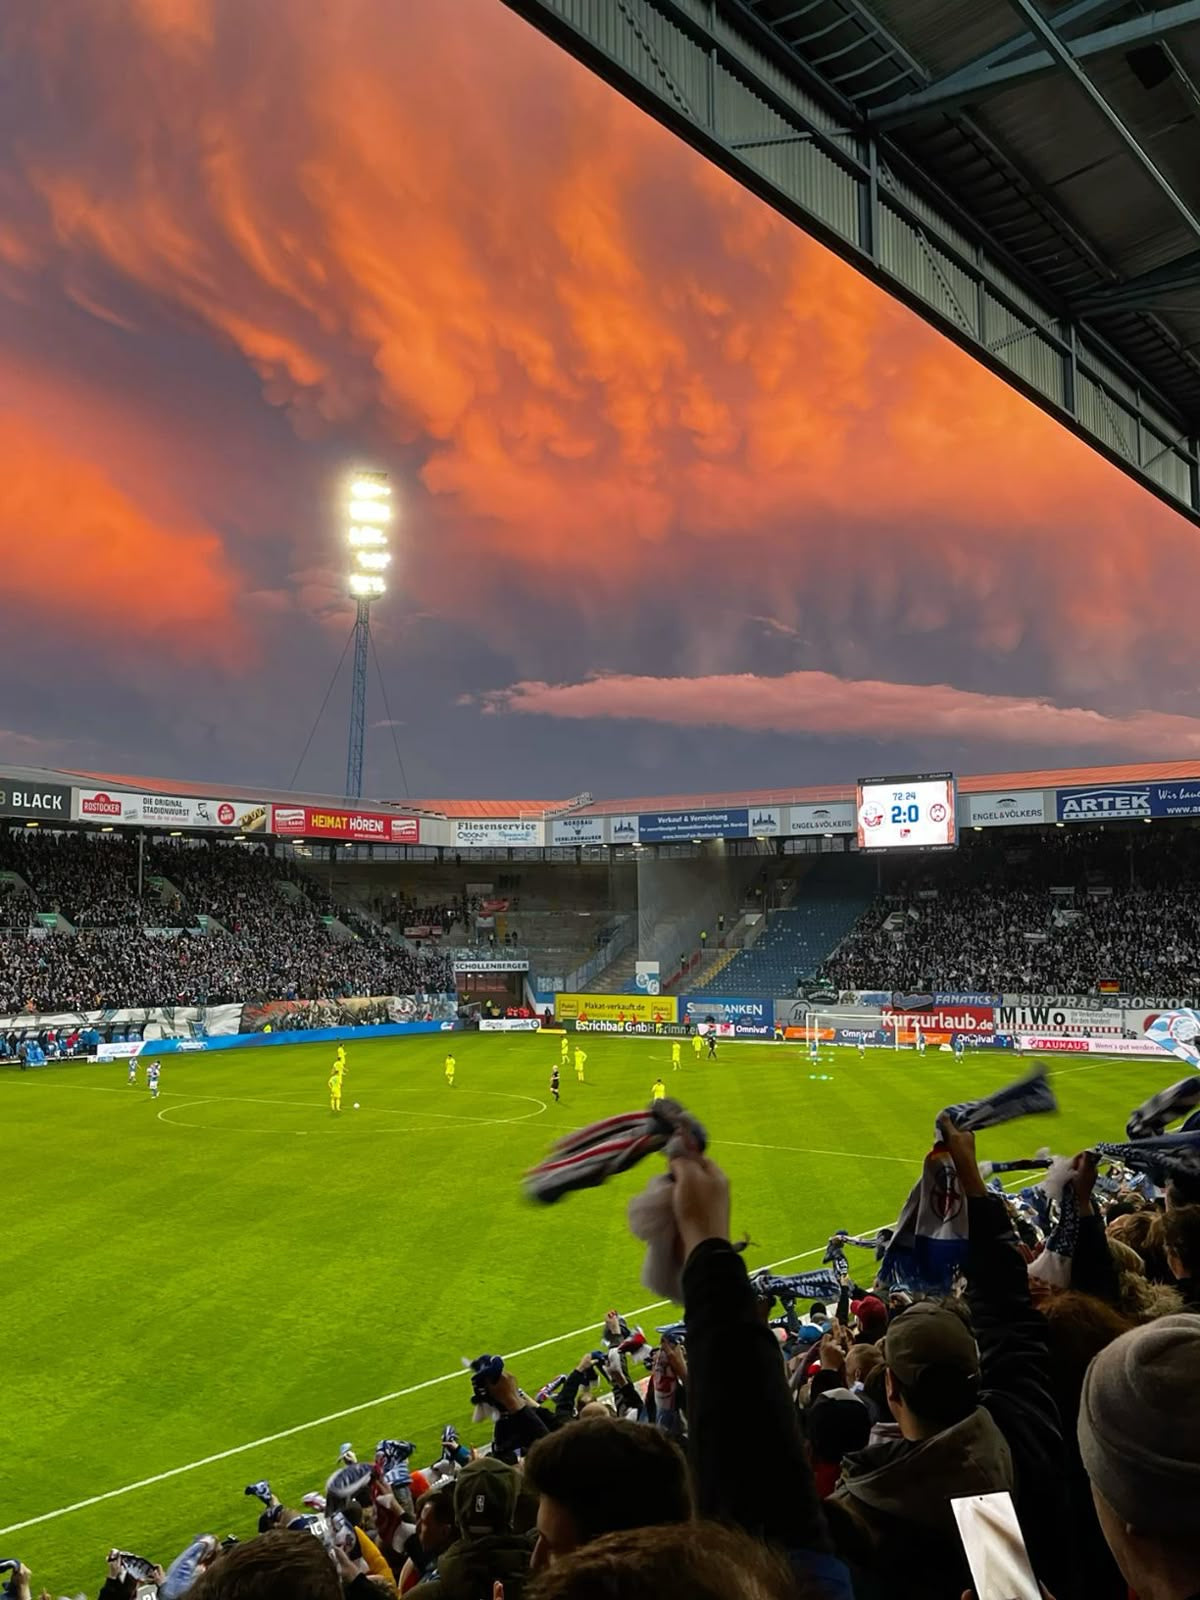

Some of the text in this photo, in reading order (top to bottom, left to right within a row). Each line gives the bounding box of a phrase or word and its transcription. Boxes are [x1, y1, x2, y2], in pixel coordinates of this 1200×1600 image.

[12, 792, 62, 810] BLACK
[143, 797, 182, 808] DIE ORIGINAL
[1064, 796, 1150, 812] ARTEK
[84, 801, 121, 815] ROSTOCKER
[143, 806, 190, 817] STADIONWURST
[891, 804, 919, 824] 2:0
[311, 814, 348, 829] HEIMAT
[349, 816, 384, 832] HÖREN!
[690, 813, 728, 822] Vermietung
[457, 822, 537, 831] Fliesenservice
[935, 994, 991, 1005] FANATICS
[1020, 994, 1103, 1010] SUPTRAS
[881, 1010, 993, 1029] Kurzurlaub.de
[736, 1025, 768, 1034] Omnival
[1038, 1040, 1088, 1050] BAUHAUS
